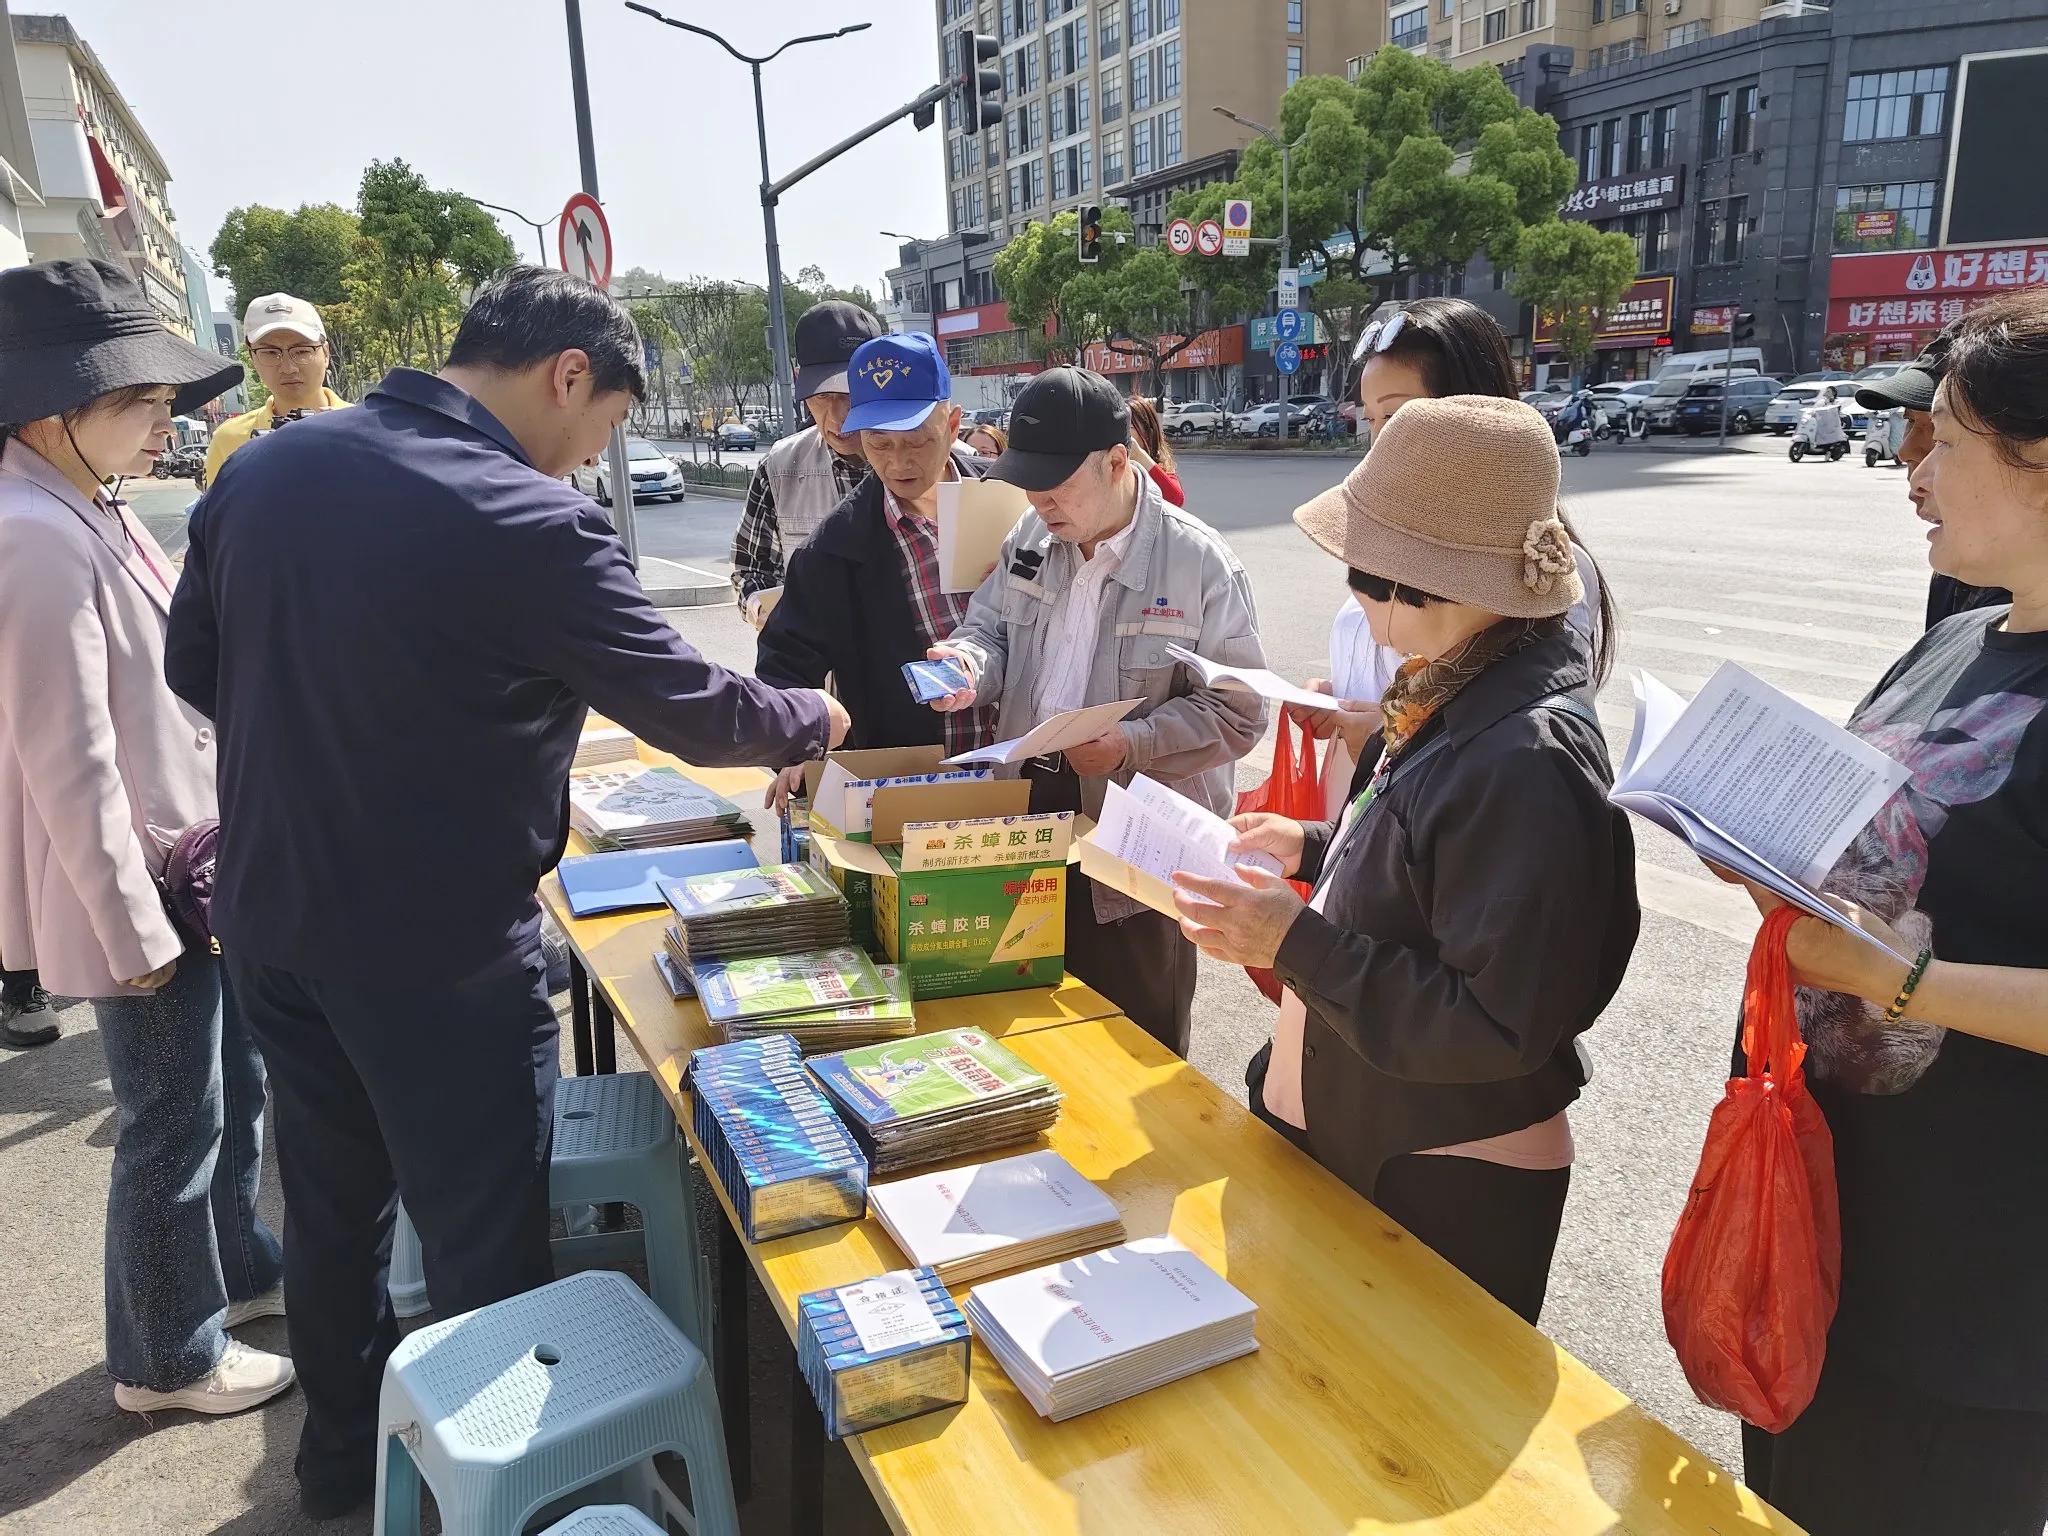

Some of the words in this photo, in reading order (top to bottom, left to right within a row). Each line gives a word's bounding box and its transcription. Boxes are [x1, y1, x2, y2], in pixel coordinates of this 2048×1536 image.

[1606, 175, 1675, 203] 镇江锅盖面
[1174, 229, 1189, 244] 50
[1606, 298, 1663, 314] 江锅盖面
[1848, 299, 1977, 327] 好想来镇
[953, 827, 1054, 850] 杀蟑胶饵
[922, 854, 982, 868] 制剂新技术
[993, 849, 1051, 862] 杀蟑新概念
[908, 914, 992, 937] 杀蟑胶饵
[859, 1285, 905, 1304] 合格证
